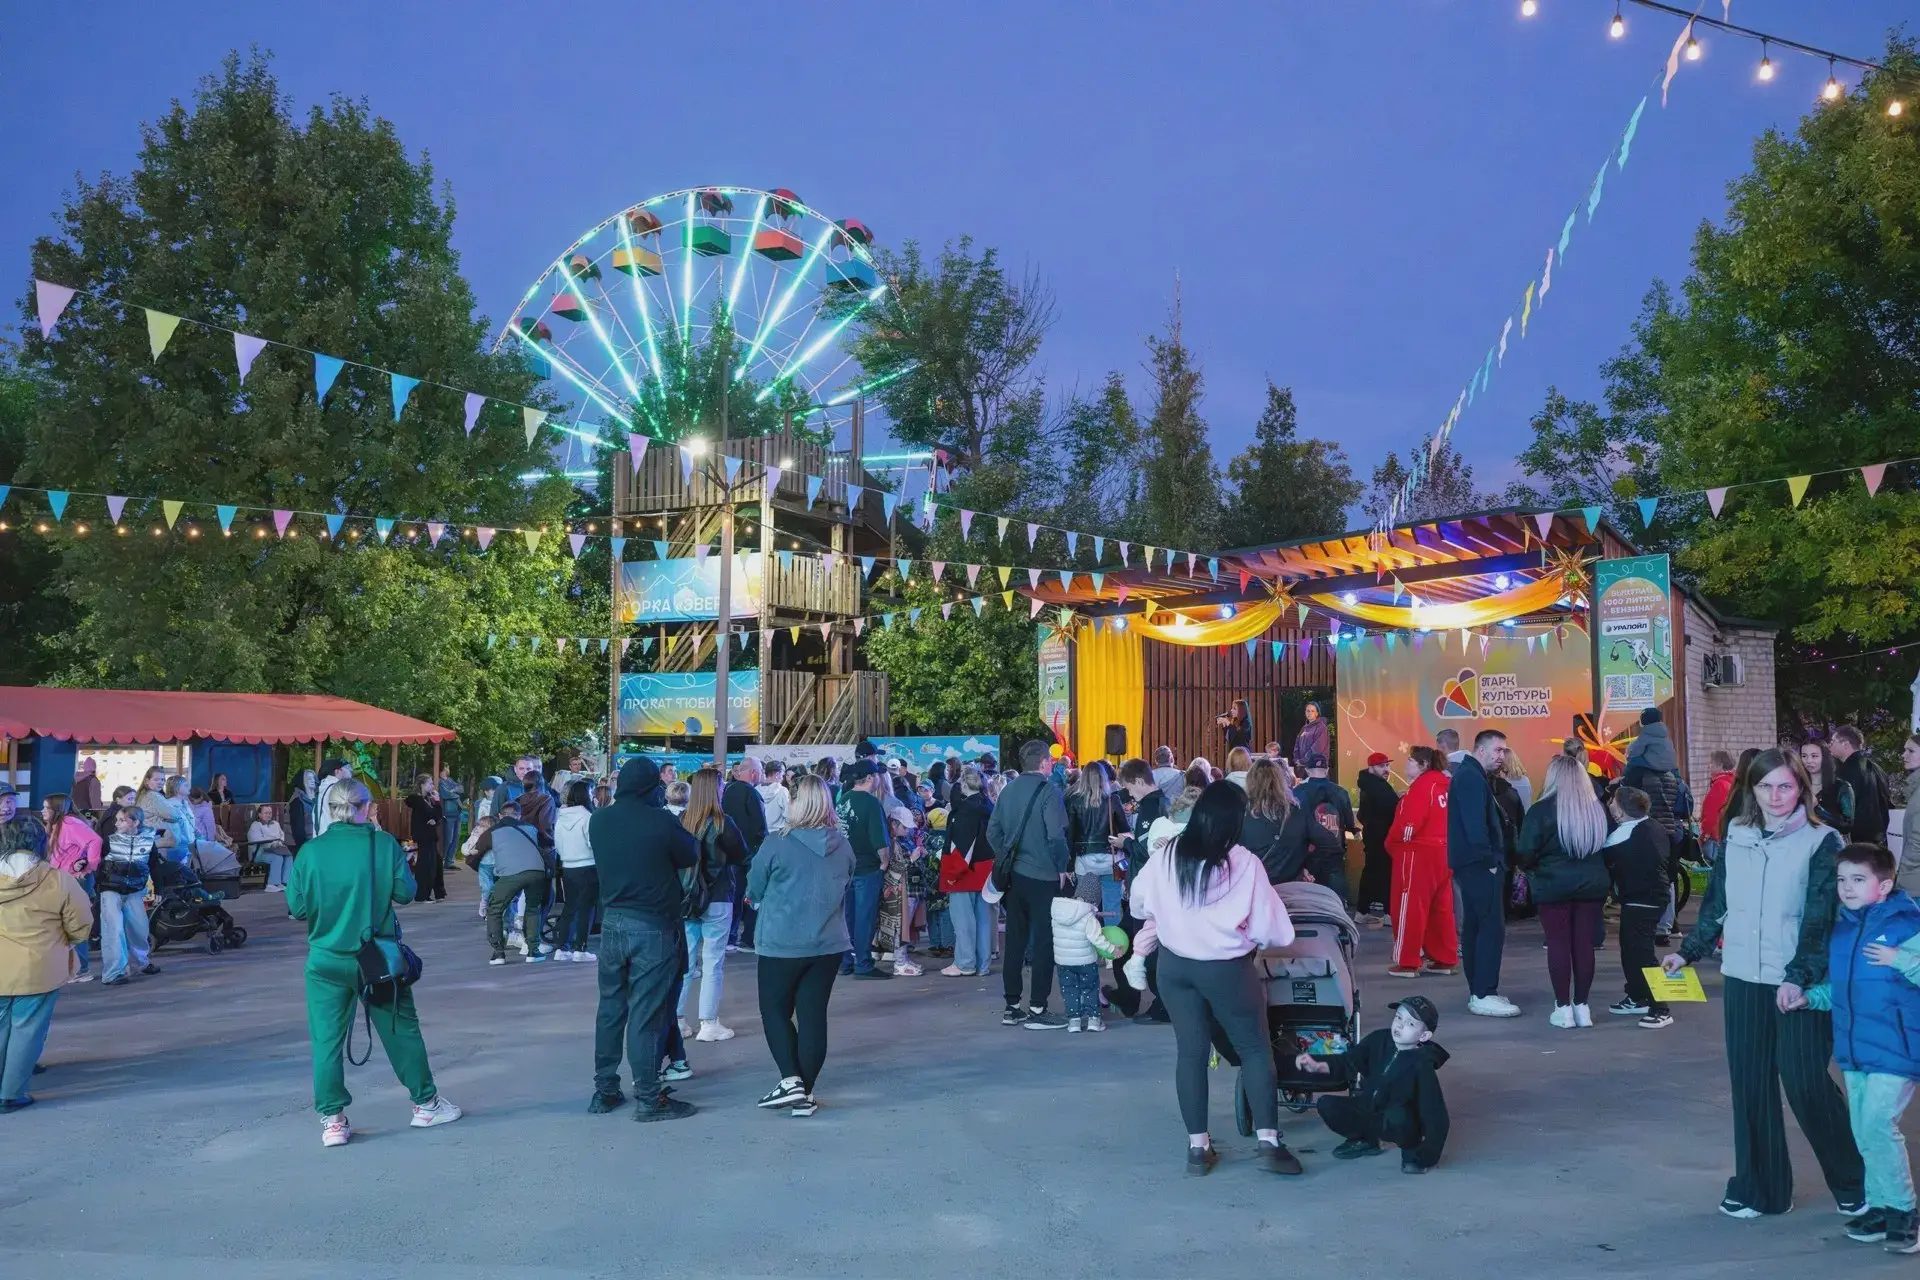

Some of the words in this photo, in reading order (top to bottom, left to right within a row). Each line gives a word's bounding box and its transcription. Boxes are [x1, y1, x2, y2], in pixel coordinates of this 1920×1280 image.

[623, 598, 672, 614] ГОРКА
[1603, 598, 1624, 606] 1000
[1625, 595, 1661, 604] ЛИТРОВ
[1613, 622, 1648, 631] УРАЛОЙЛ
[1481, 676, 1515, 686] ПАРК
[1482, 690, 1550, 701] КУЛЬТУРЫ
[623, 697, 672, 710] ПРОКАТ
[676, 695, 752, 709] ТЮБИГОВ
[1494, 705, 1548, 716] ОТДЫХА
